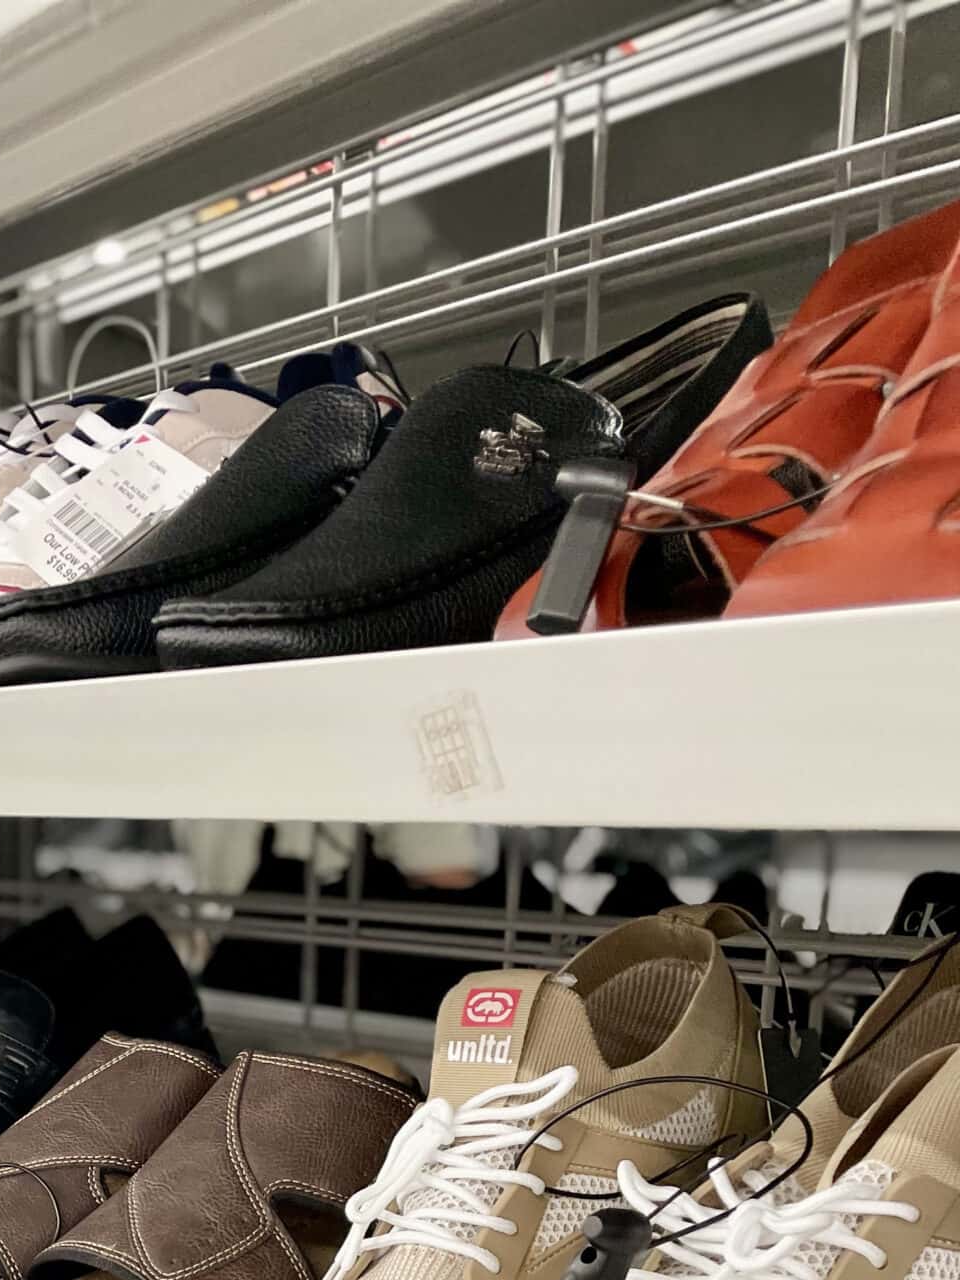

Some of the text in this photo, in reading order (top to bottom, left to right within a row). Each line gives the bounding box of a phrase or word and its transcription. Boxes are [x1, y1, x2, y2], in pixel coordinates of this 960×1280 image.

[43, 533, 62, 550] Our
[59, 546, 78, 566] Low
[46, 555, 78, 581] $16.99
[447, 1034, 513, 1064] unltd.
